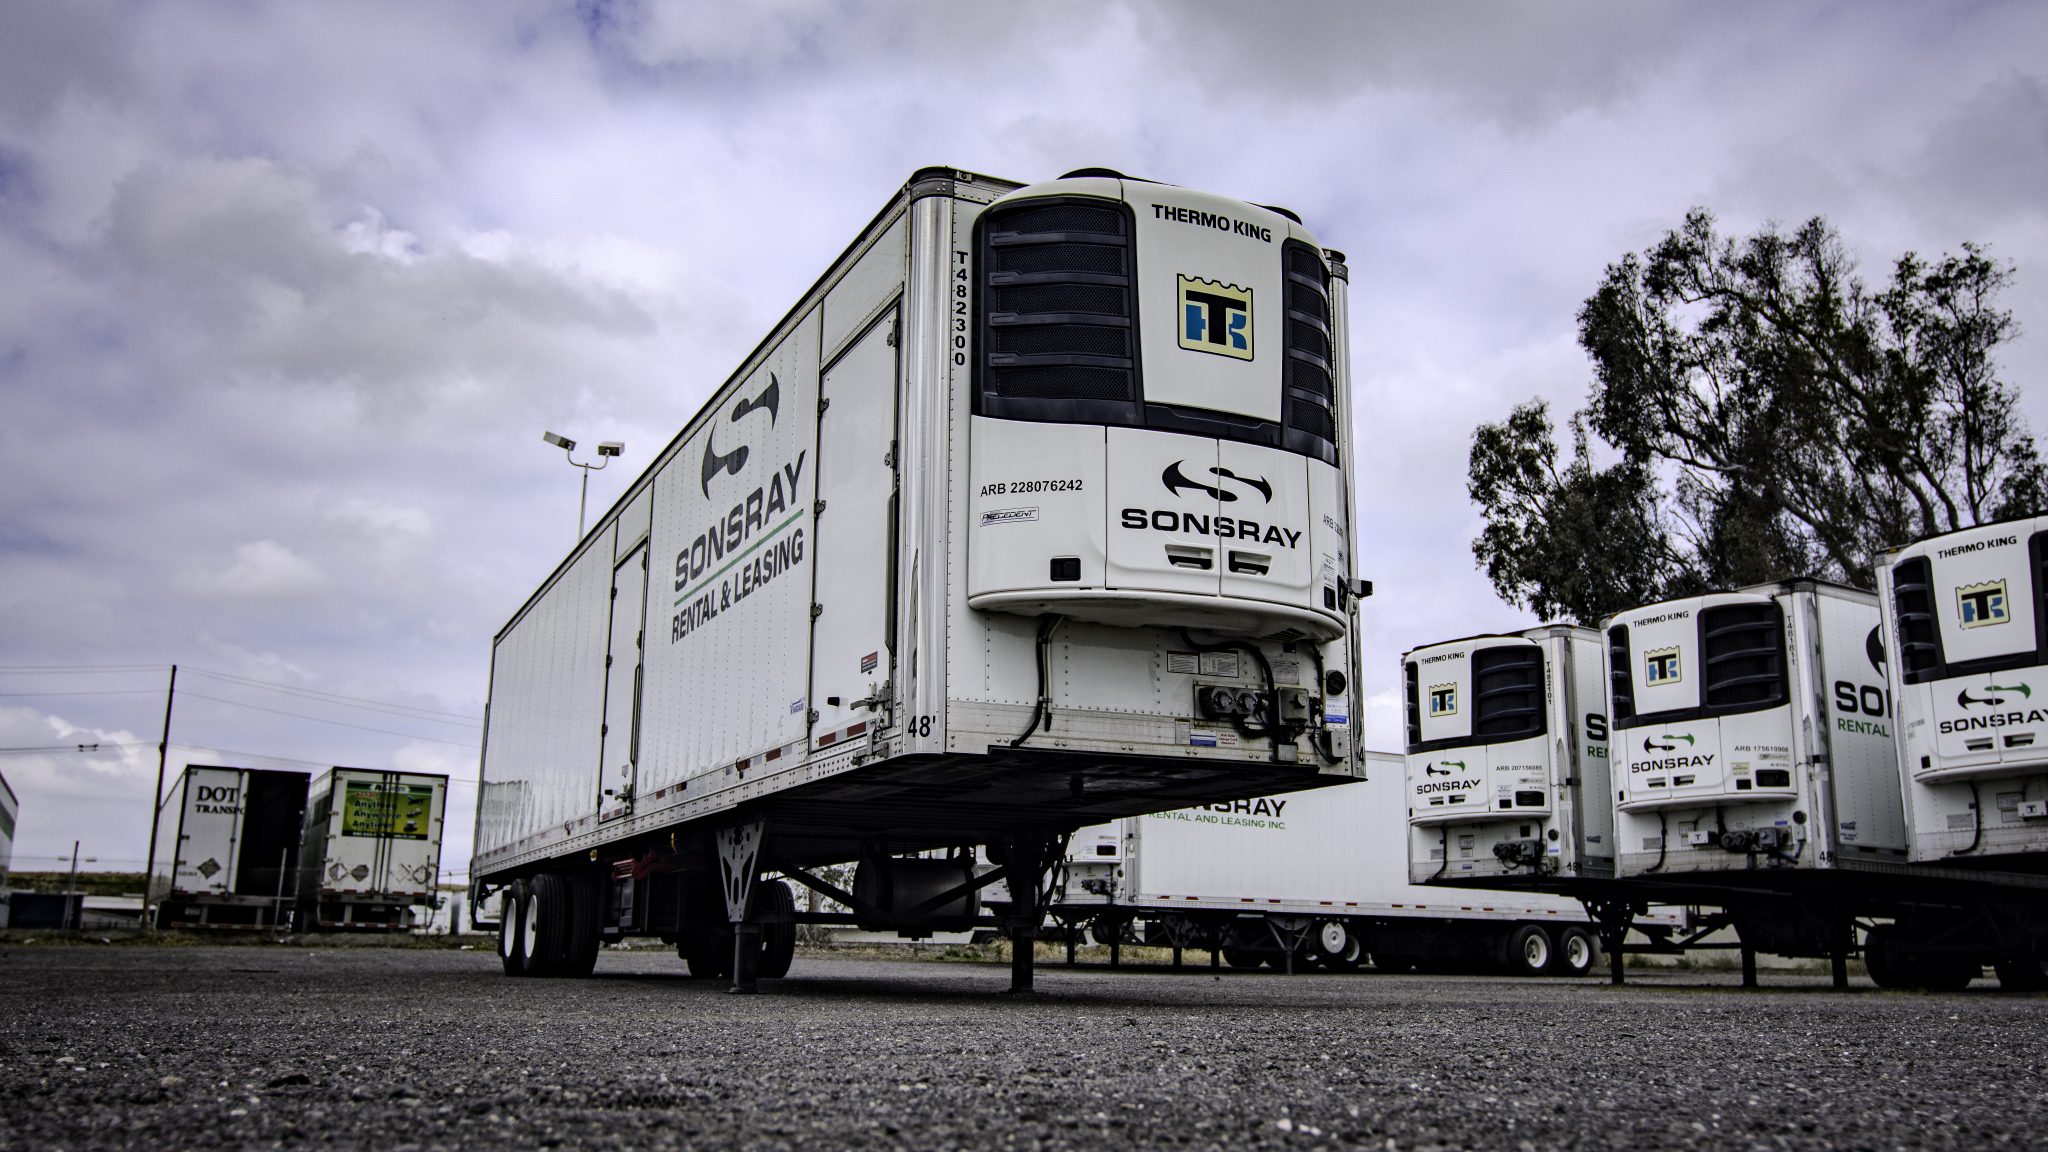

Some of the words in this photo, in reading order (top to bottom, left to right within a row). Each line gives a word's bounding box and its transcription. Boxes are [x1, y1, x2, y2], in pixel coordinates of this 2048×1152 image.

[1151, 204, 1230, 232] THERMO
[1233, 219, 1272, 243] KING
[955, 251, 969, 366] T482300
[980, 483, 1006, 497] ARB
[1010, 480, 1083, 494] 228076242
[675, 449, 806, 592] SONSRAY
[1121, 508, 1302, 549] SONSRAY
[1937, 542, 1985, 559] THERMO
[1987, 535, 2017, 548] KING
[672, 589, 718, 645] RENTAL
[720, 580, 731, 612] &
[734, 528, 804, 604] LEASING
[1633, 615, 1666, 628] THERMO
[1667, 611, 1689, 621] KING
[1421, 655, 1447, 665] THERMO
[1447, 651, 1465, 660] KING
[1835, 680, 1892, 718] SO
[907, 715, 936, 738] 48'
[1837, 718, 1890, 738] RENTAL
[1631, 754, 1715, 773] SONSRAY
[197, 785, 240, 802] DOT
[1417, 779, 1481, 794] SONSRAY
[1192, 798, 1287, 817] SRAY
[1149, 810, 1192, 821] RENTAL
[1195, 814, 1218, 824] AND
[1221, 816, 1265, 828] LEASING
